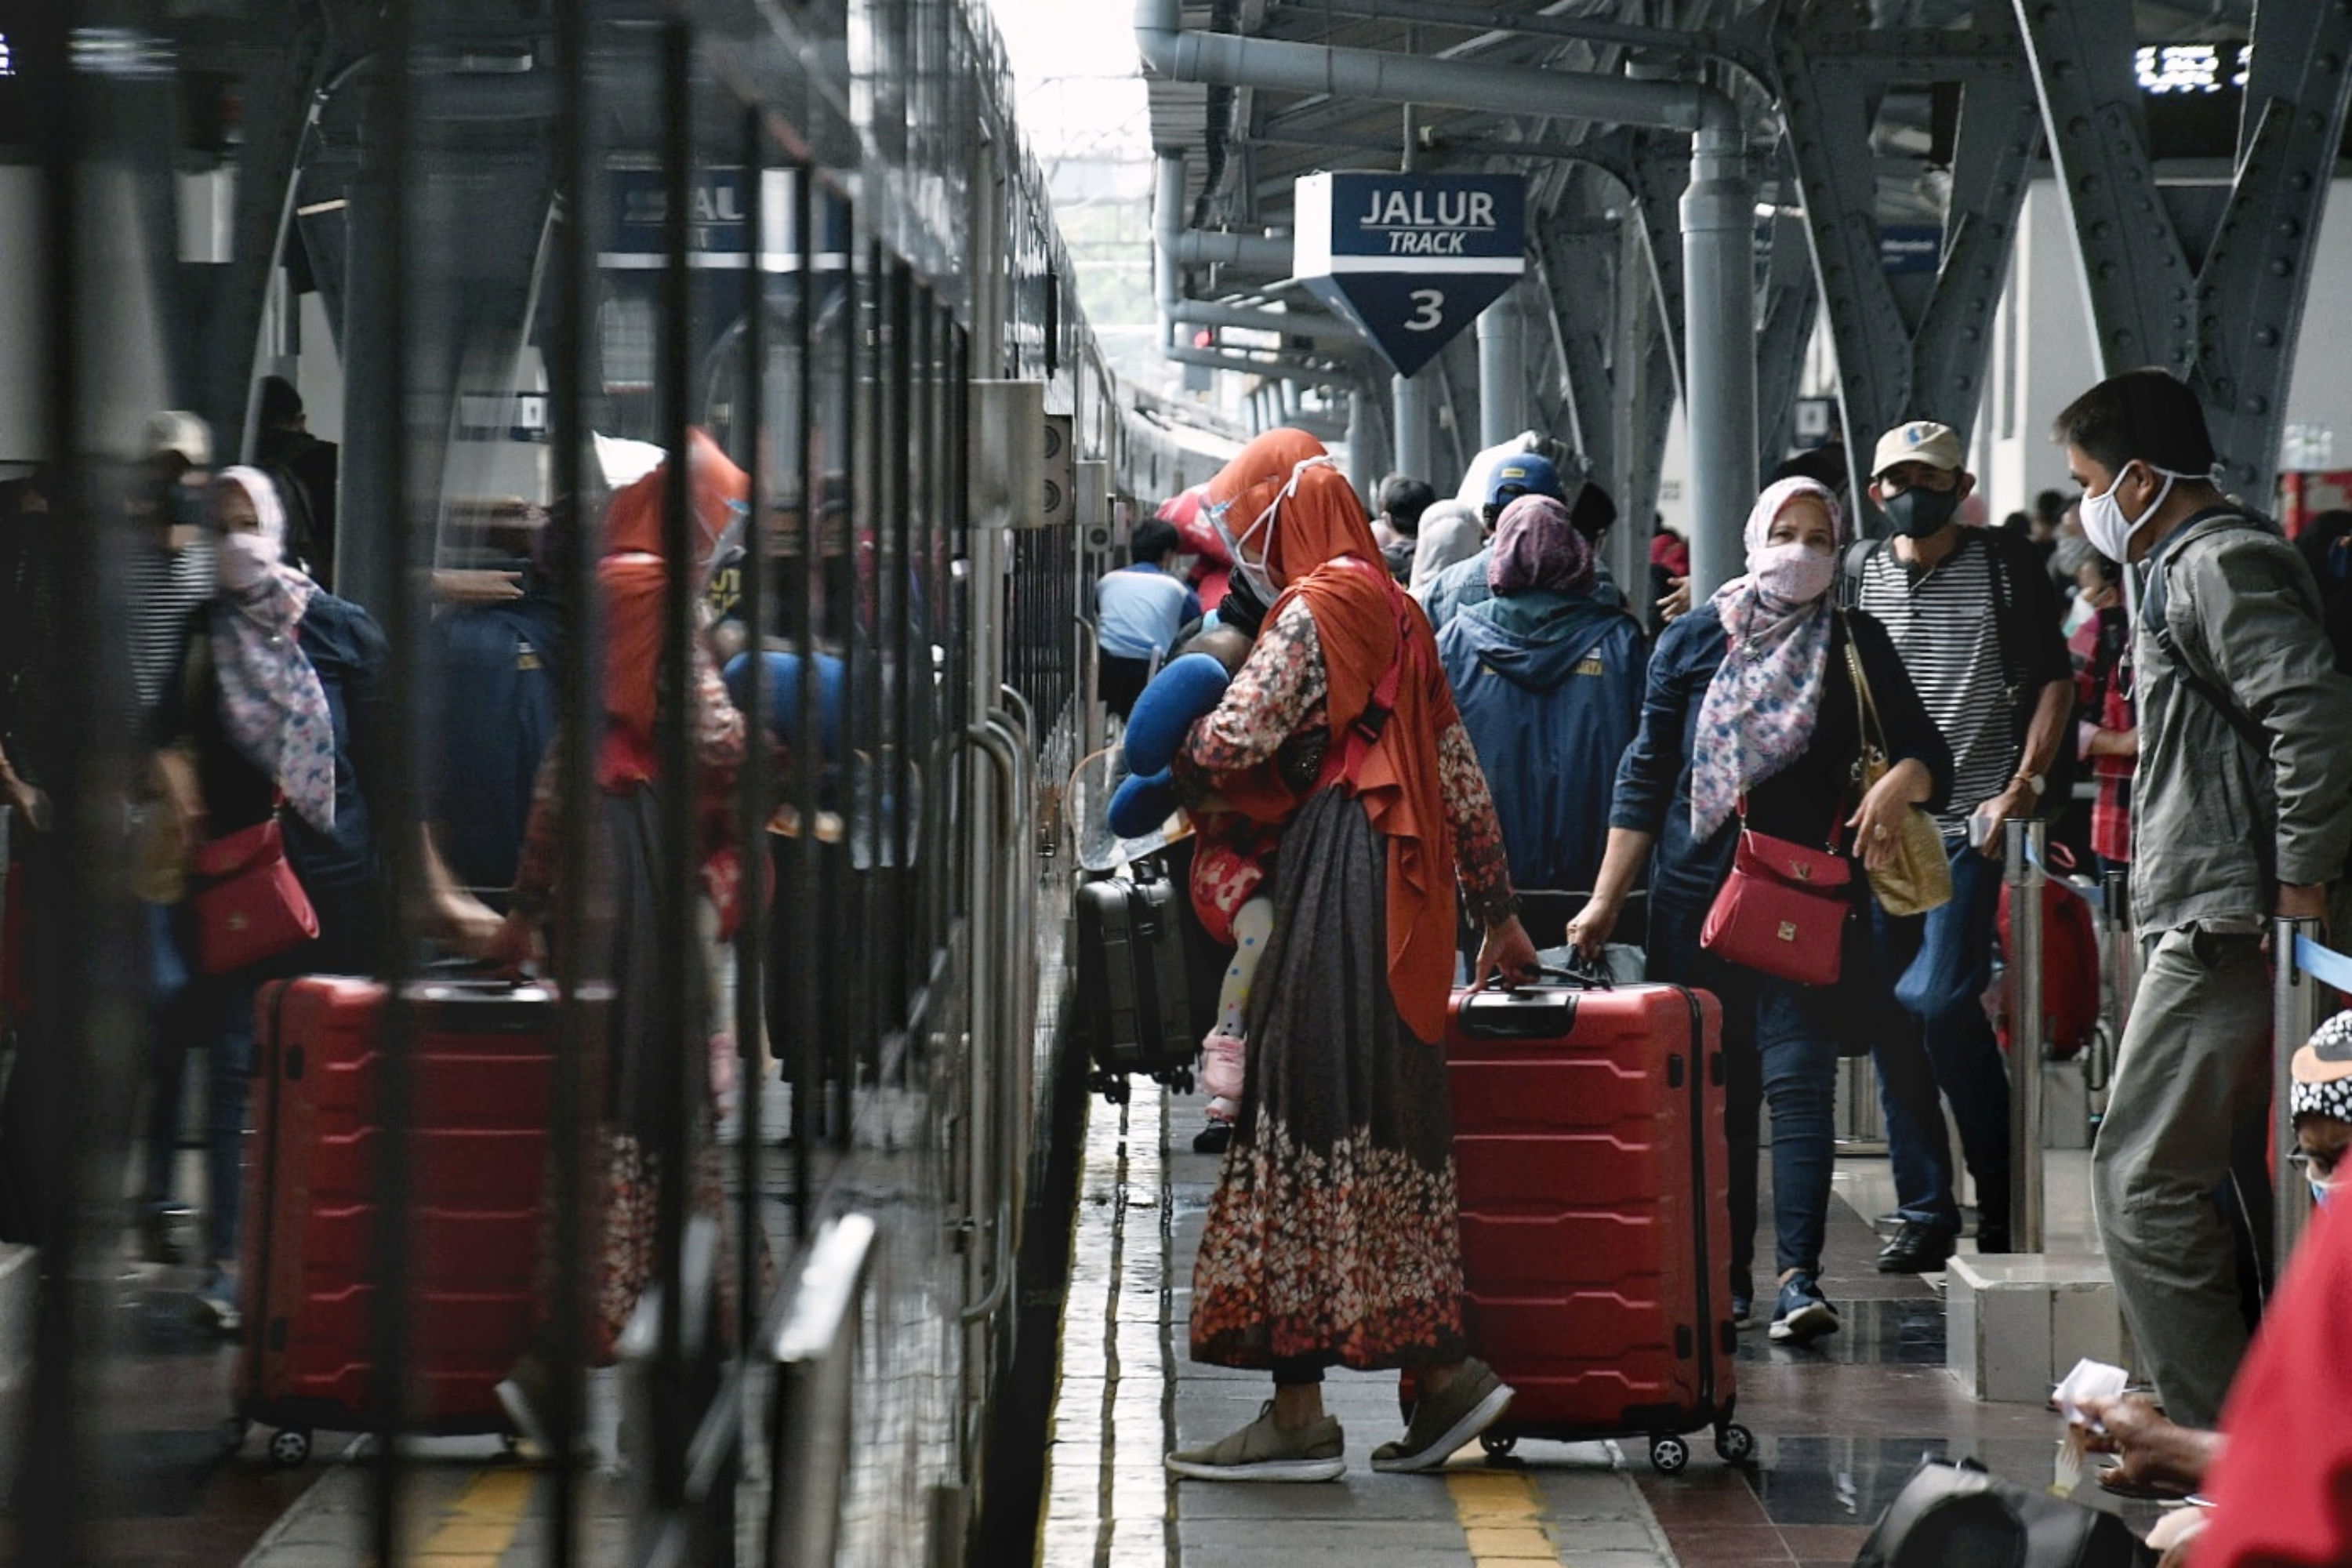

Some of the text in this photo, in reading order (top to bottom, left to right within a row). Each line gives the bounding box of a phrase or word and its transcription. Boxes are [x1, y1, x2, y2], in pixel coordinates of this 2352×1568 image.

[1359, 191, 1496, 226] JALUR
[1388, 230, 1466, 254] TRACK
[1403, 289, 1444, 331] 3
